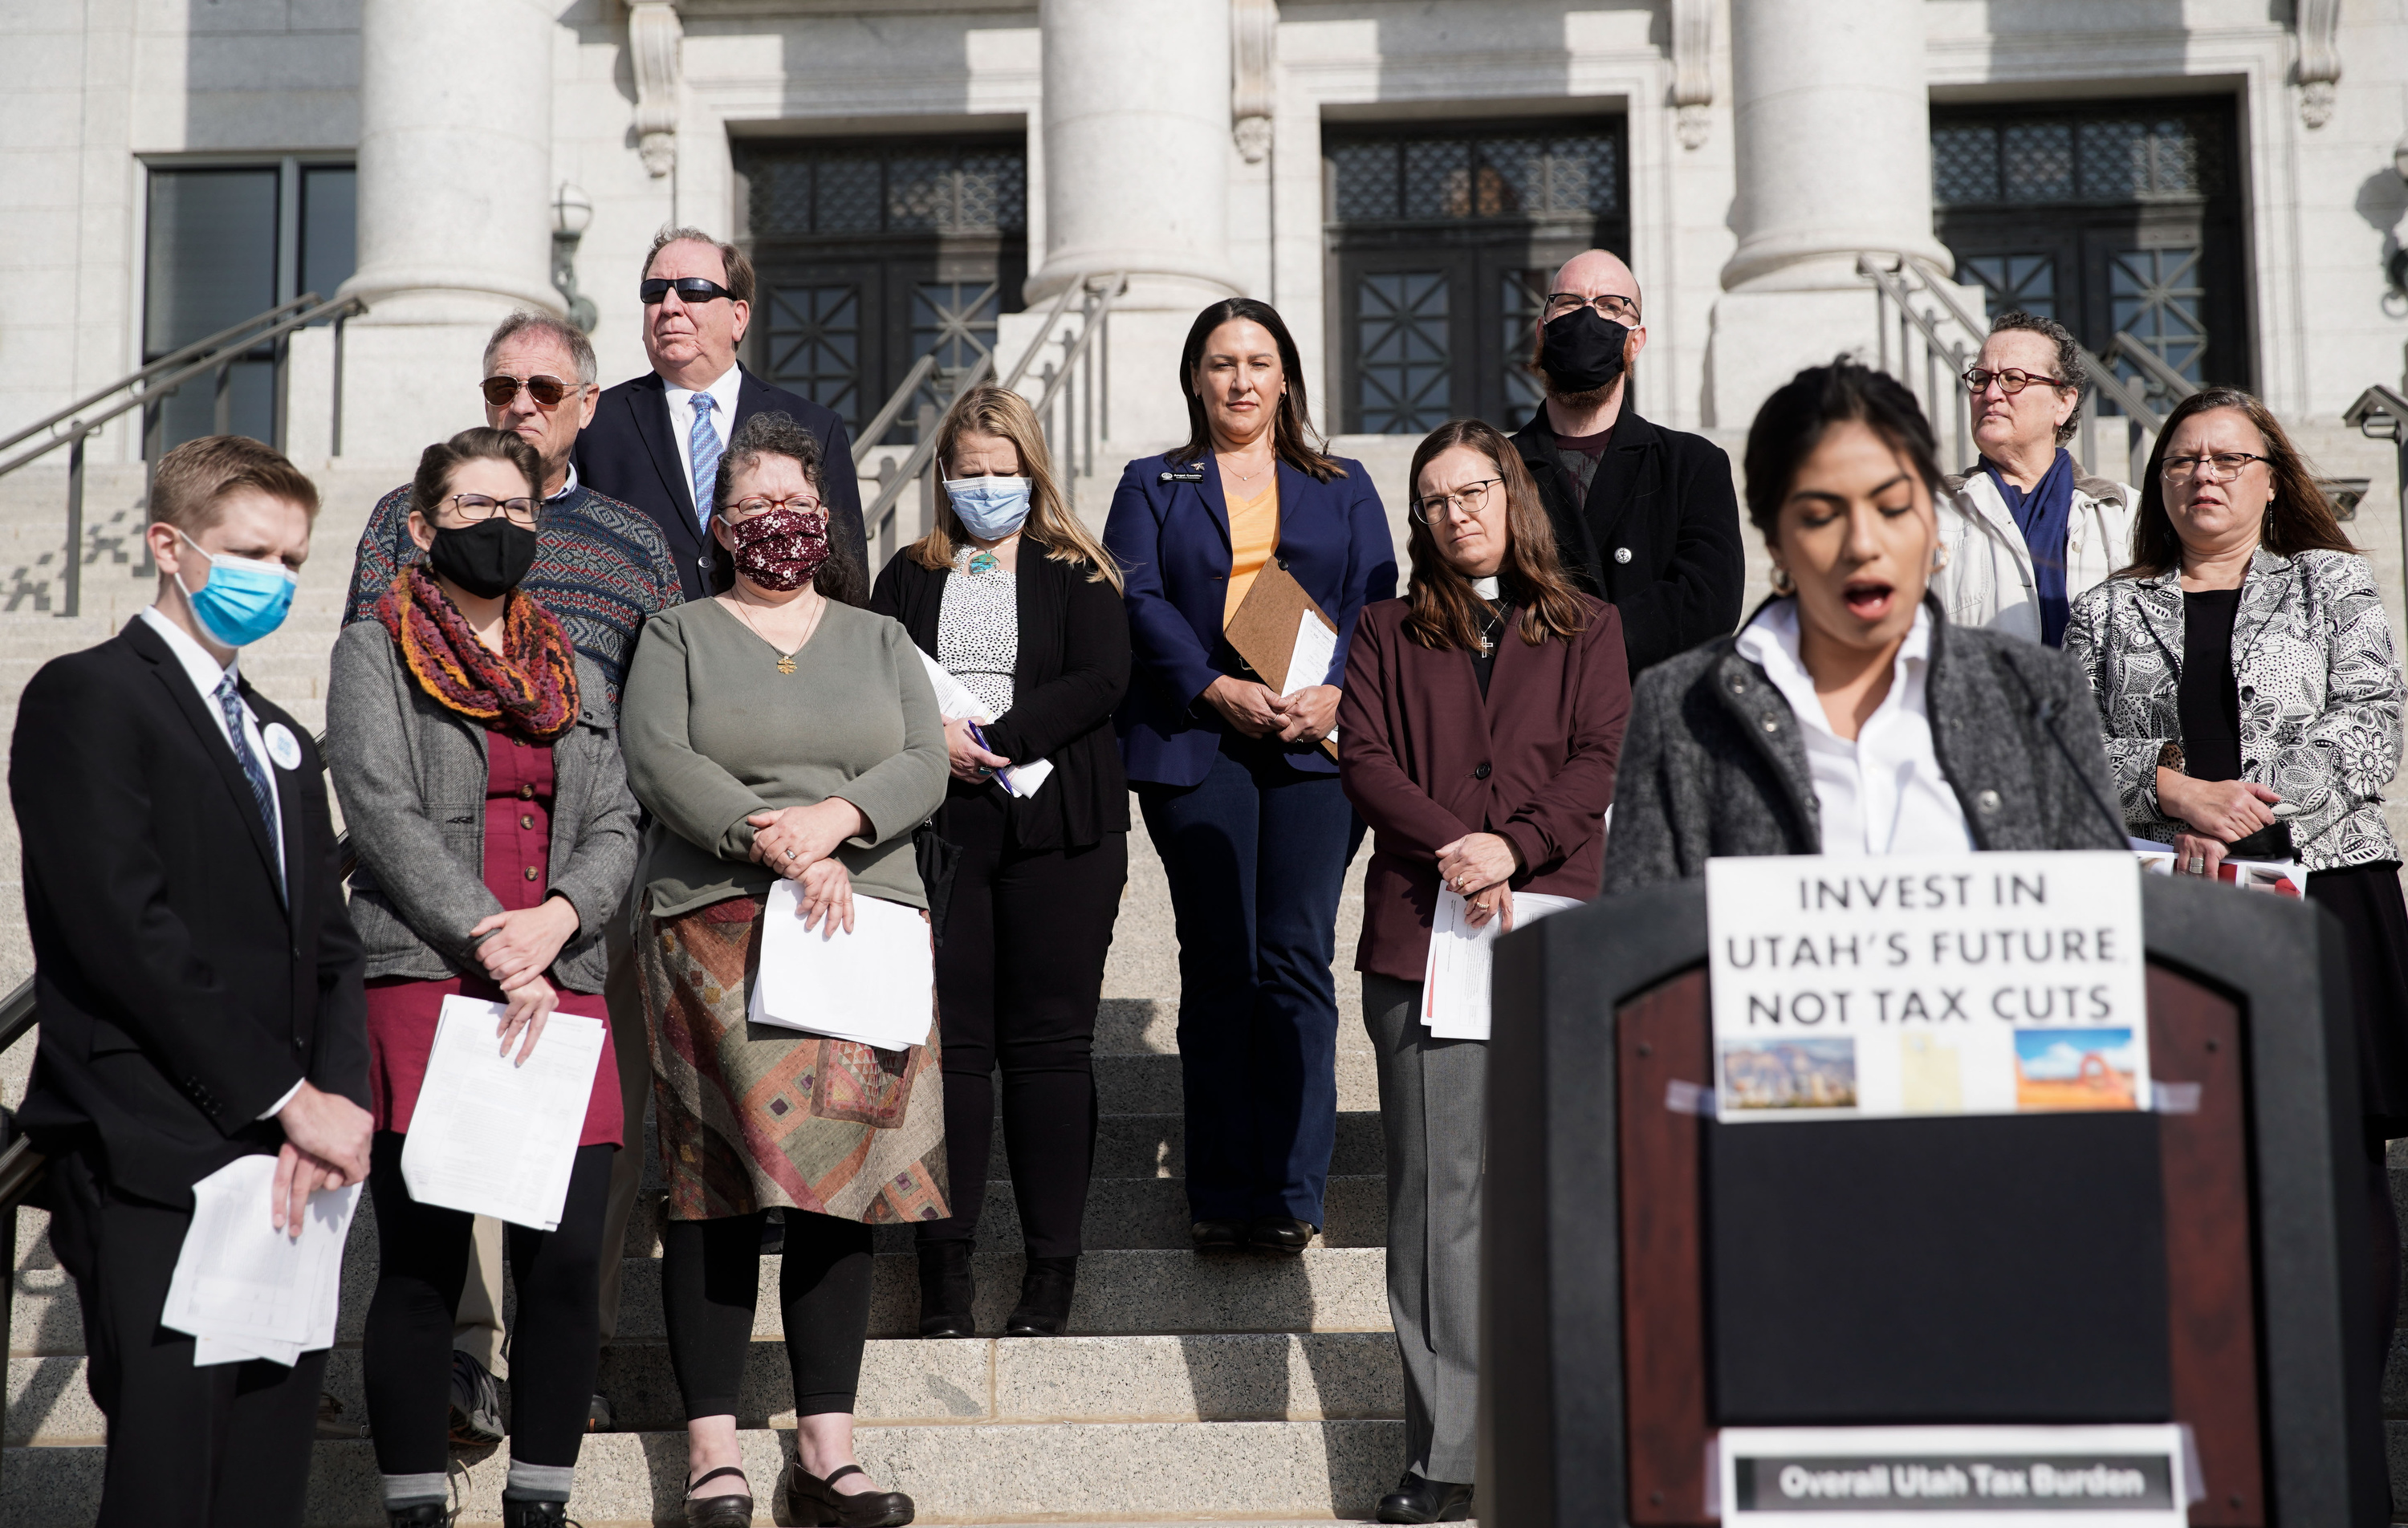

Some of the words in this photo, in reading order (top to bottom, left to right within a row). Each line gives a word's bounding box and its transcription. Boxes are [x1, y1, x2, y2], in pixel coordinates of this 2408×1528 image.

[1799, 874, 1971, 911] INVEST
[1993, 873, 2047, 907] IN
[1726, 932, 1910, 969] UTAH'S
[1747, 990, 1851, 1026] NOT
[1873, 988, 1968, 1023] TAX
[1990, 984, 2113, 1022] CUTS
[1779, 1465, 1891, 1498] Overall
[1893, 1465, 1968, 1498] Utah
[1969, 1465, 2028, 1498] Tax
[2030, 1464, 2146, 1498] Burden
